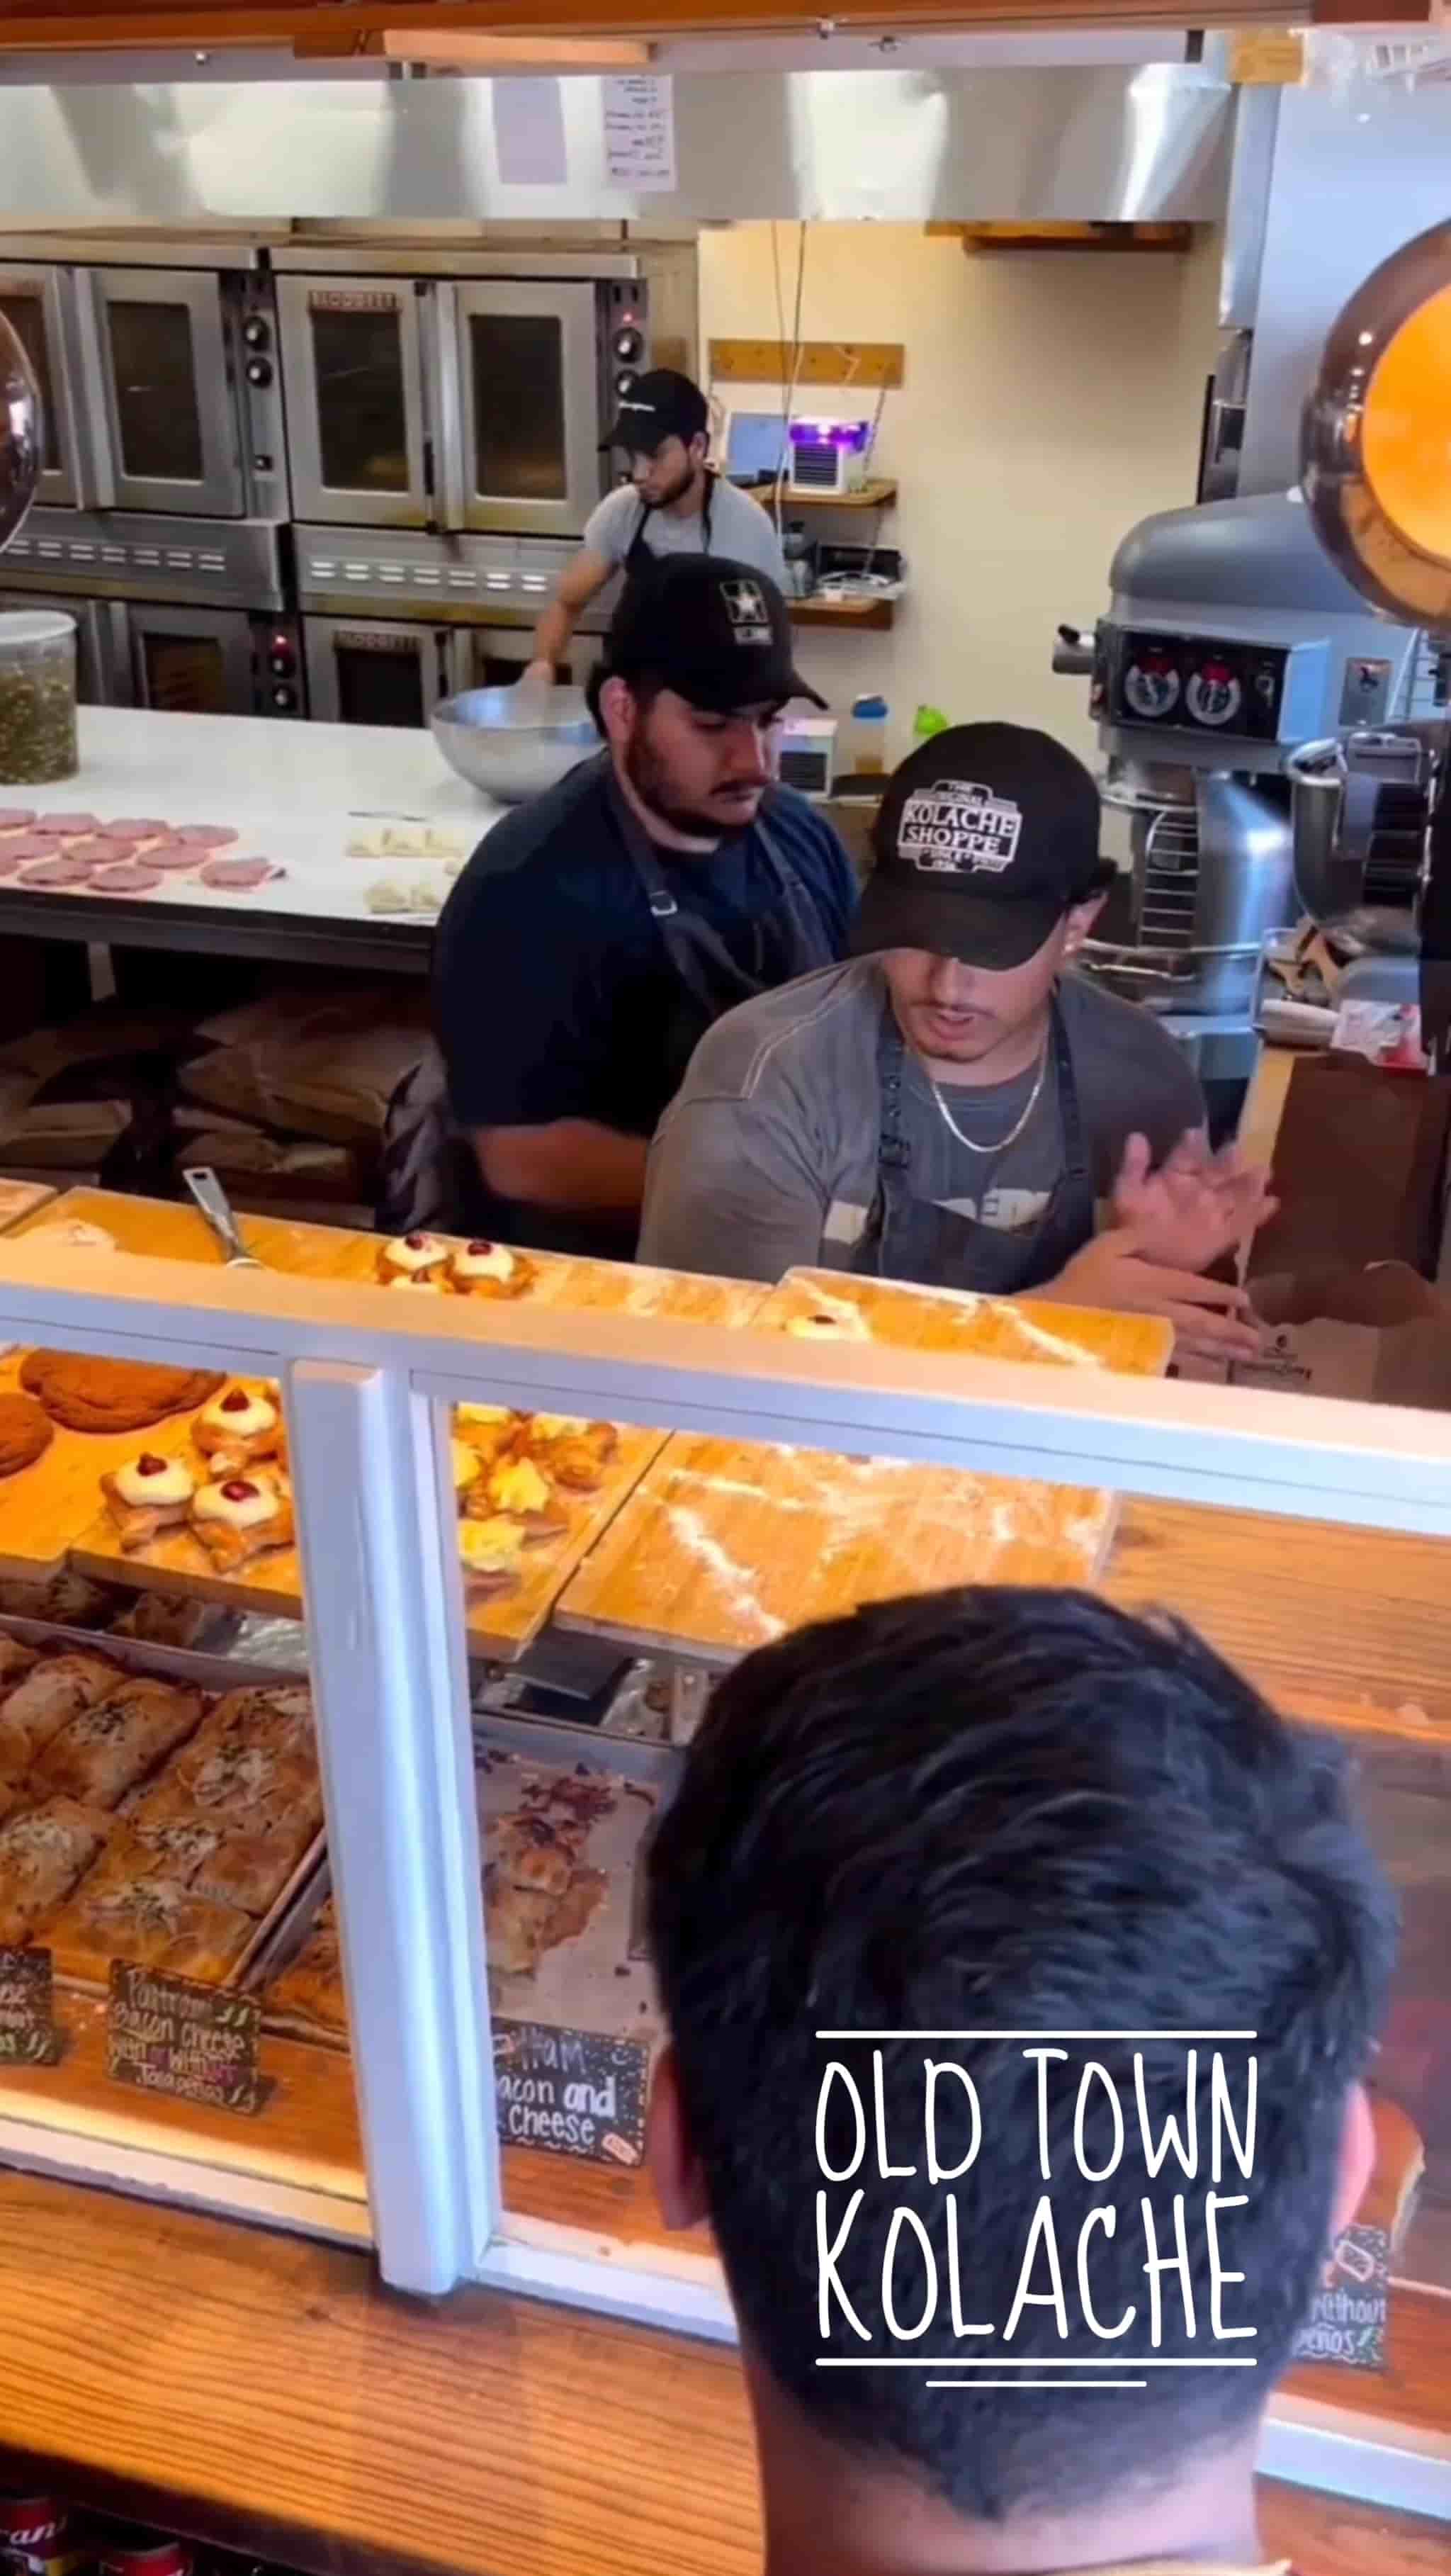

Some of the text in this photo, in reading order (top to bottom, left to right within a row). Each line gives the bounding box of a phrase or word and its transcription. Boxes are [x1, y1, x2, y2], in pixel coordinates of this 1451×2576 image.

[901, 801, 1015, 838] KOLACHE
[903, 824, 1002, 853] SHOPPE
[497, 2074, 615, 2118] acon and
[509, 2104, 596, 2145] Cheese
